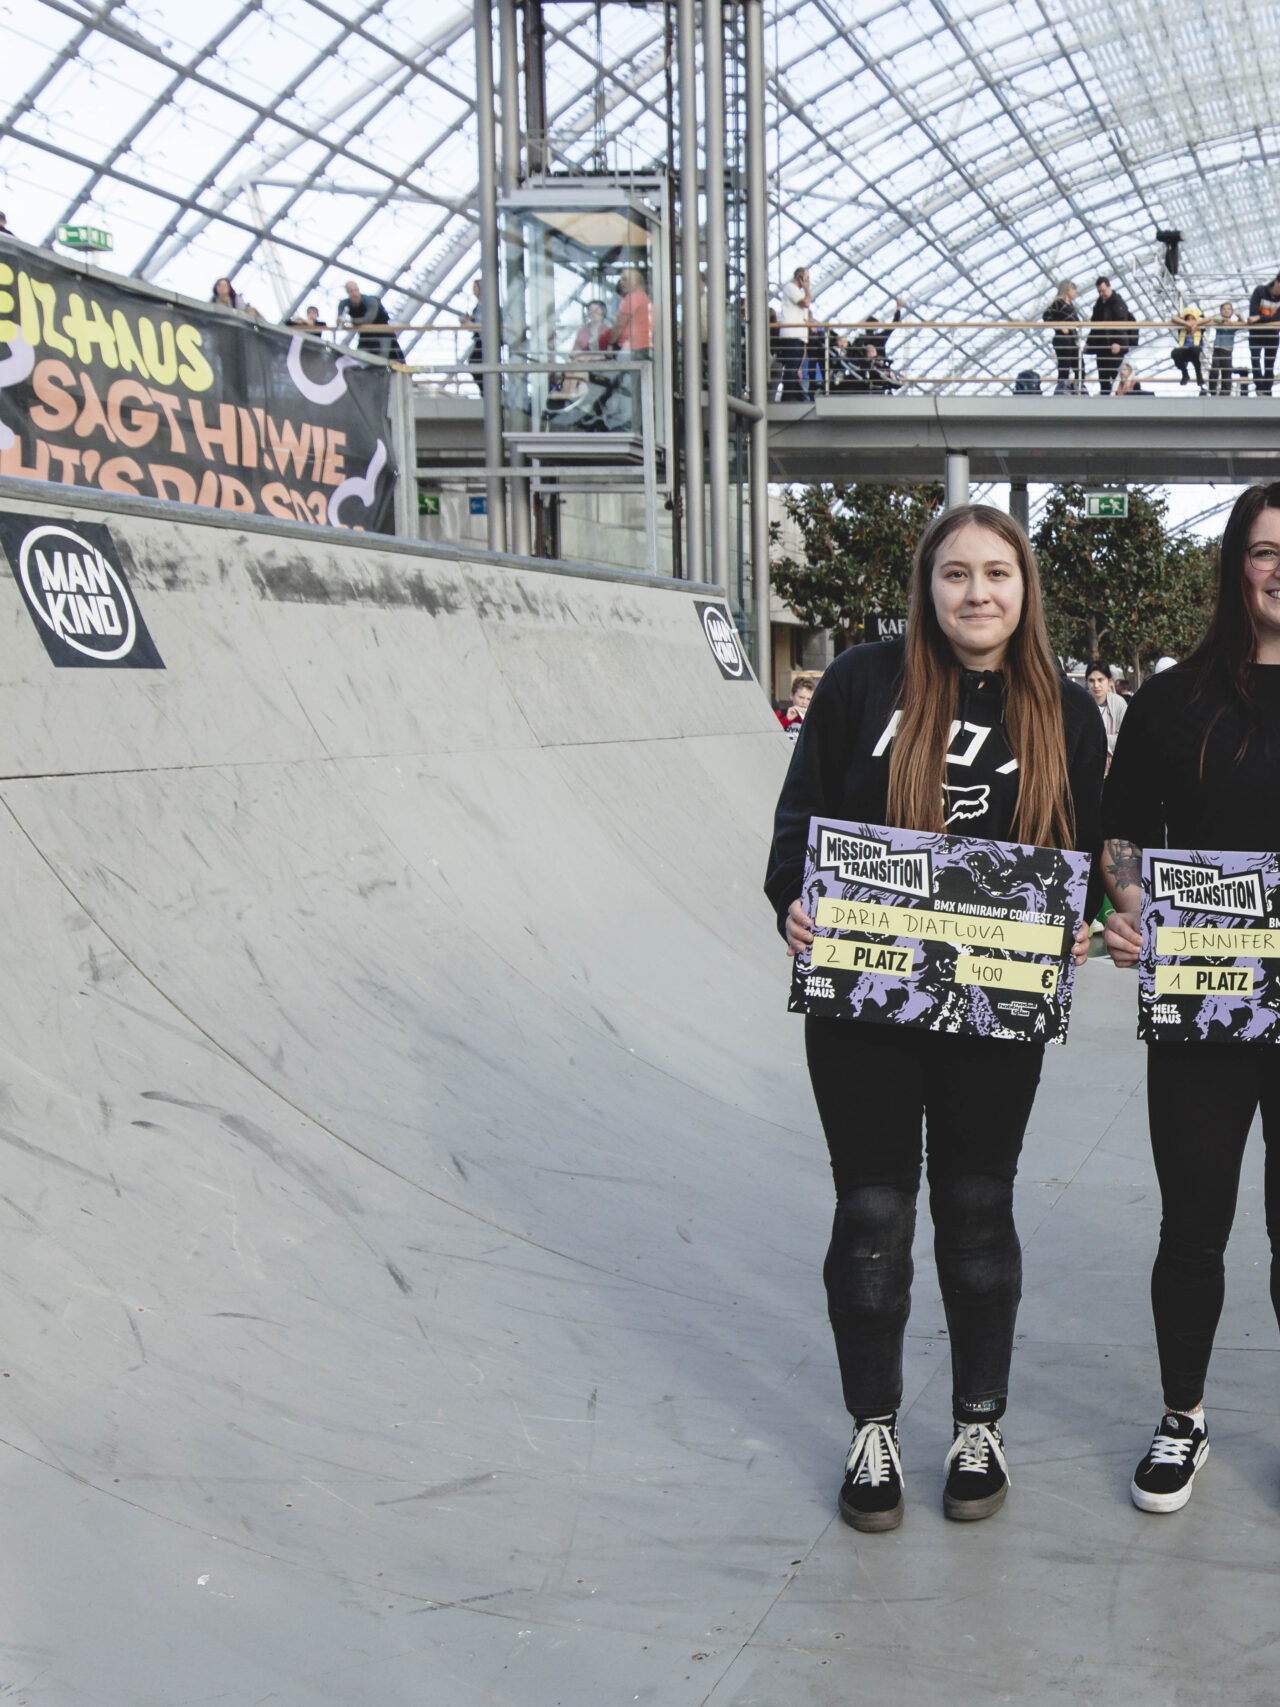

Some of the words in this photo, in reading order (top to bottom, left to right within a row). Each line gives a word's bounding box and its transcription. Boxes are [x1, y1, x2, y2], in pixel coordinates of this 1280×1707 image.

[30, 359, 186, 454] SAGT
[266, 414, 346, 486] WIE
[34, 548, 112, 595] MAN
[45, 592, 123, 640] KIND
[831, 906, 890, 929] DARIA
[903, 914, 1005, 942] DIATLOVA
[934, 900, 955, 912] BMX
[957, 902, 1008, 918] MINIRAMP
[1009, 907, 1052, 923] CONTEST
[1053, 914, 1066, 925] 22
[1170, 931, 1275, 952] JENNIFER
[826, 944, 841, 963] 2
[853, 947, 909, 972] PLATZ
[805, 976, 832, 988] HEIZ
[971, 963, 1003, 982] 400
[1041, 969, 1055, 988] €
[1169, 973, 1181, 989] 1
[1196, 971, 1248, 991] PLATZ
[804, 986, 836, 999] HAUS
[1151, 1003, 1179, 1014] HEIZ
[1151, 1013, 1181, 1025] HAUS
